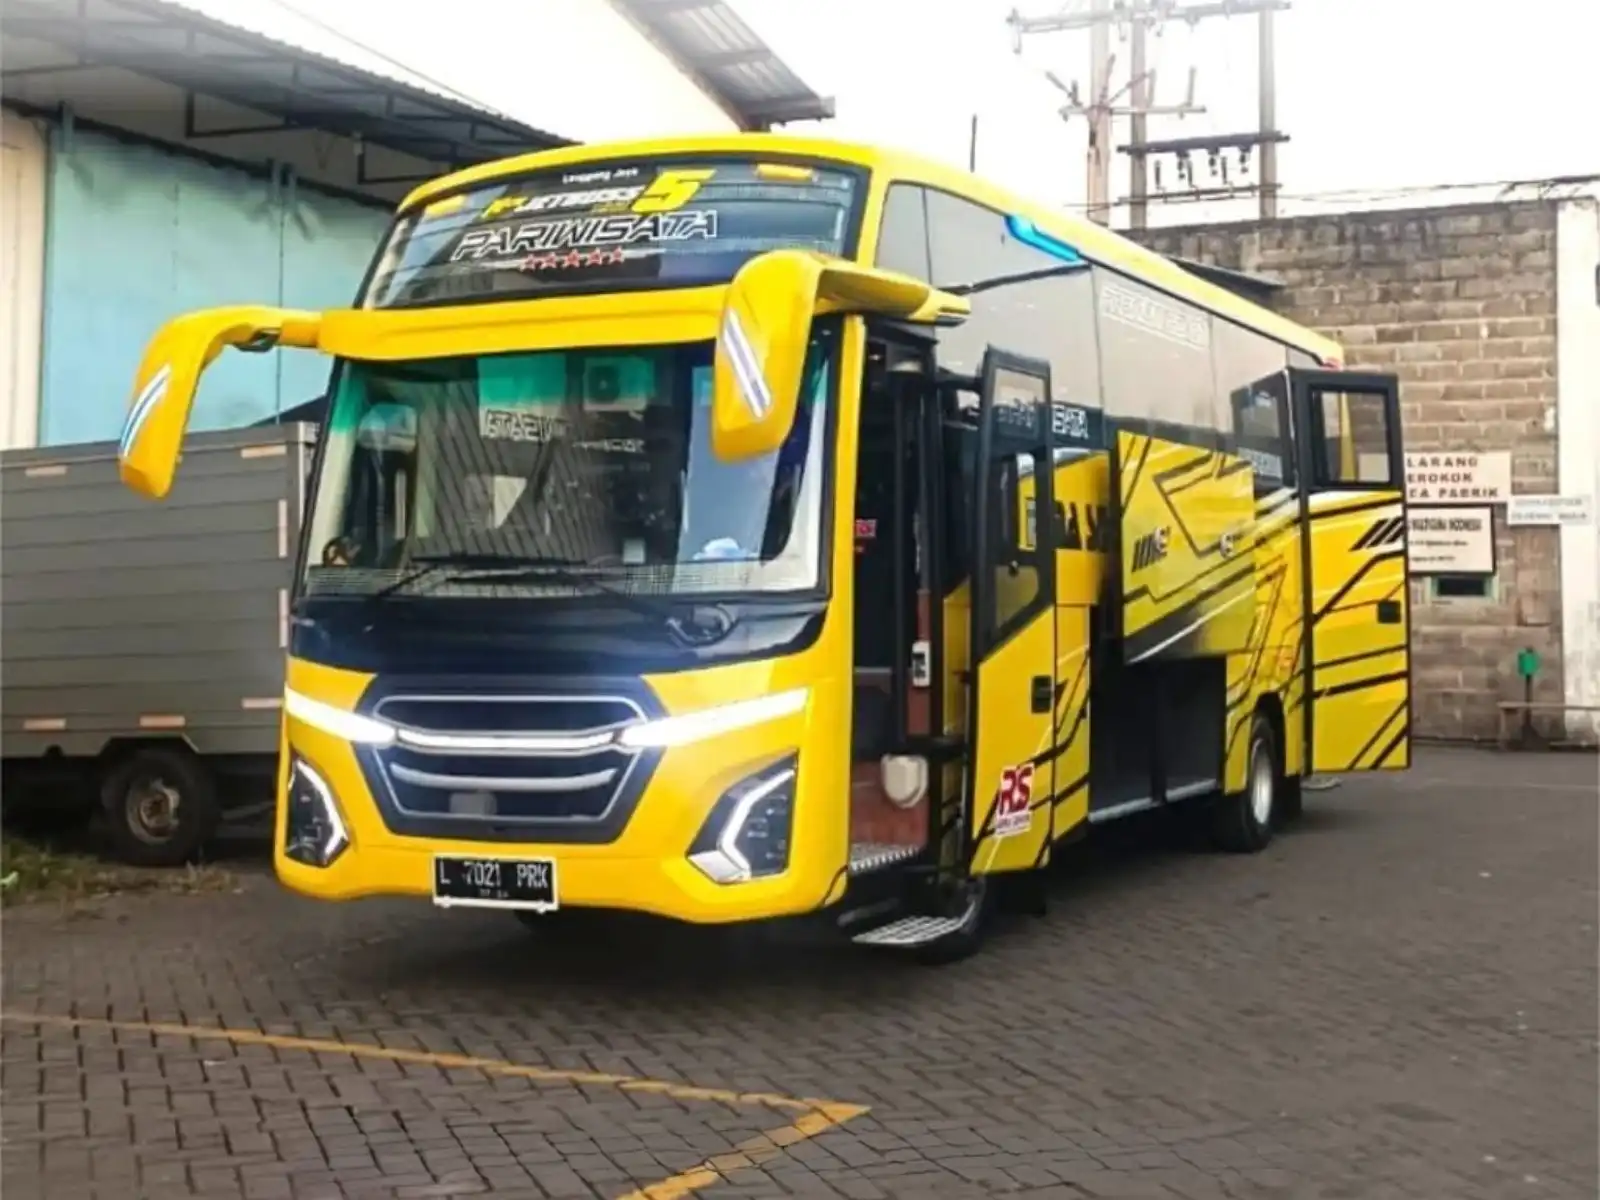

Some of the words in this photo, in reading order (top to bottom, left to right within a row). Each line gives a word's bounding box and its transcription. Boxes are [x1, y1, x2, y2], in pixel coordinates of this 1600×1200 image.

[631, 168, 718, 214] 5
[451, 209, 718, 261] PARIWISATA
[1439, 487, 1499, 498] PABRIK
[439, 860, 451, 885] L
[463, 861, 502, 887] 7021
